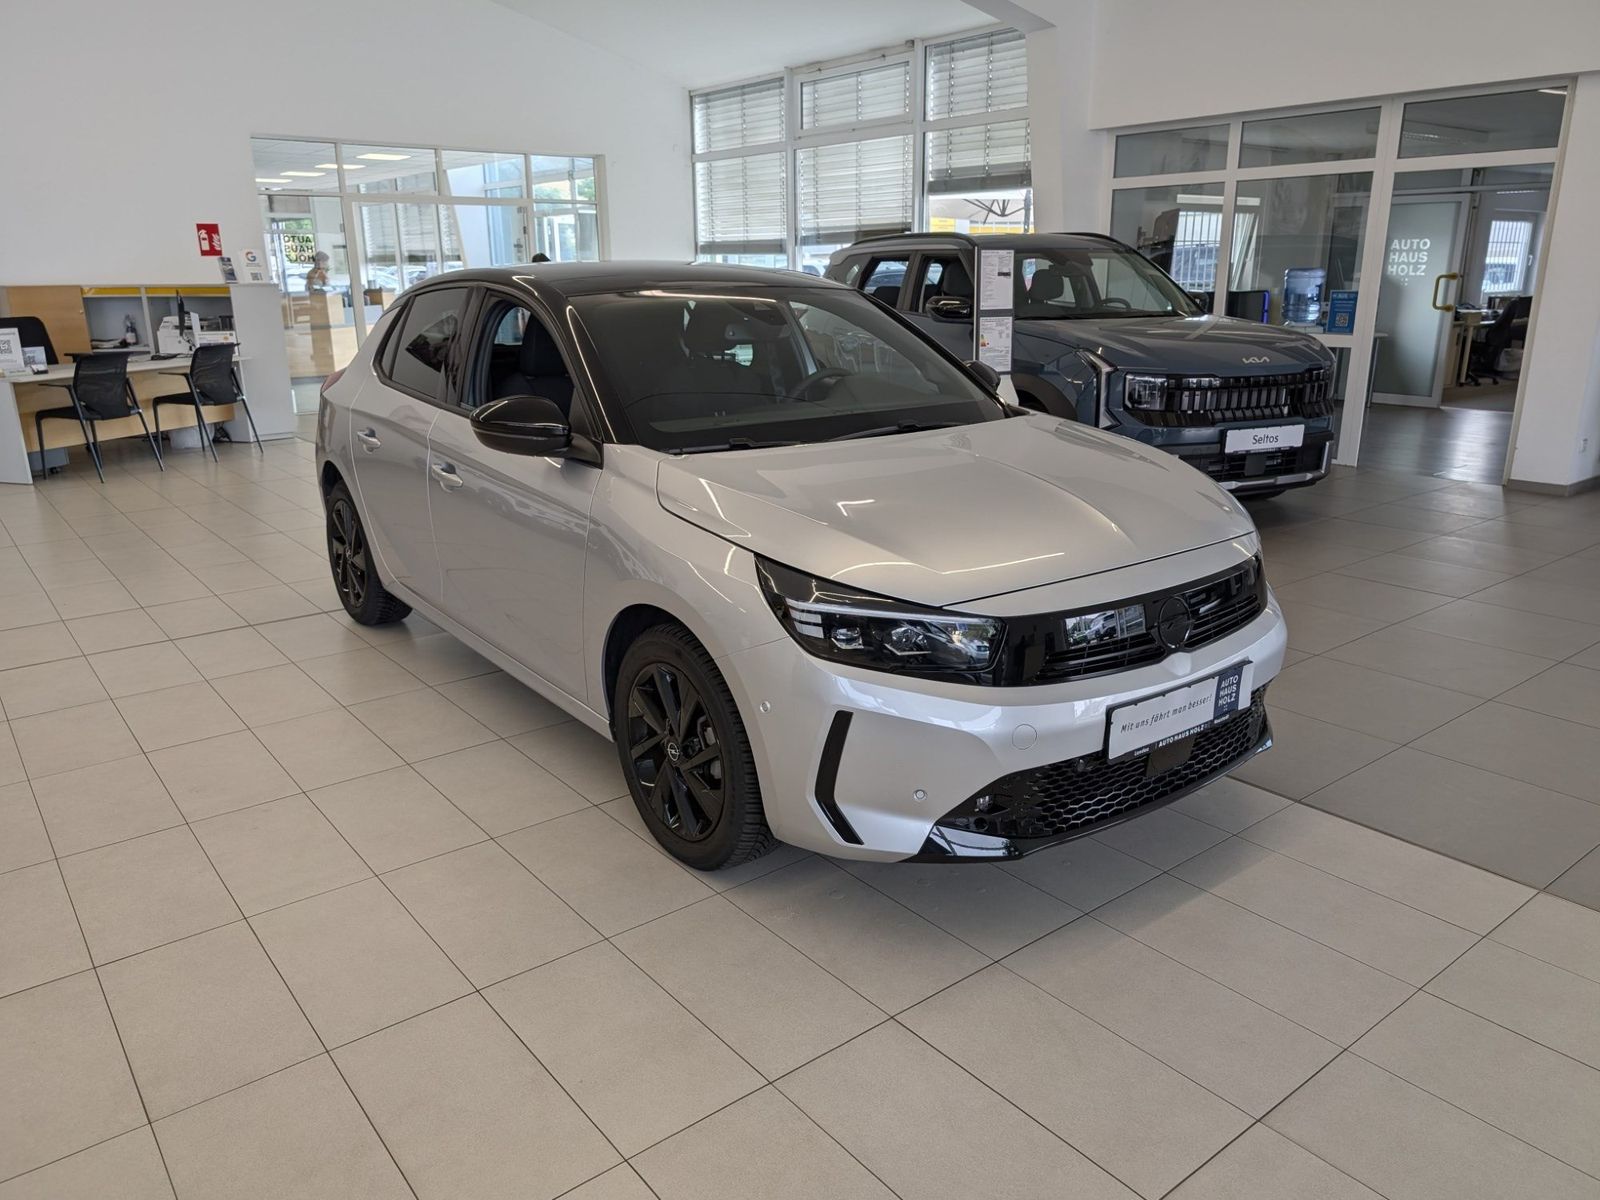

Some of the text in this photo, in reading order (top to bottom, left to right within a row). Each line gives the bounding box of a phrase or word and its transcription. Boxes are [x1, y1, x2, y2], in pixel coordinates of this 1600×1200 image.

[1390, 238, 1431, 250] AUTO
[1389, 251, 1428, 263] HAUS
[1387, 264, 1427, 276] HOLZ
[1252, 434, 1279, 445] Seltos
[1220, 674, 1239, 689] AUTO
[1219, 684, 1237, 697] HAUS
[1217, 693, 1236, 707] HOLZ
[1120, 693, 1213, 733] Mit uns fährt man besser!
[1158, 736, 1174, 747] AUTO
[1189, 724, 1204, 735] HOLZ
